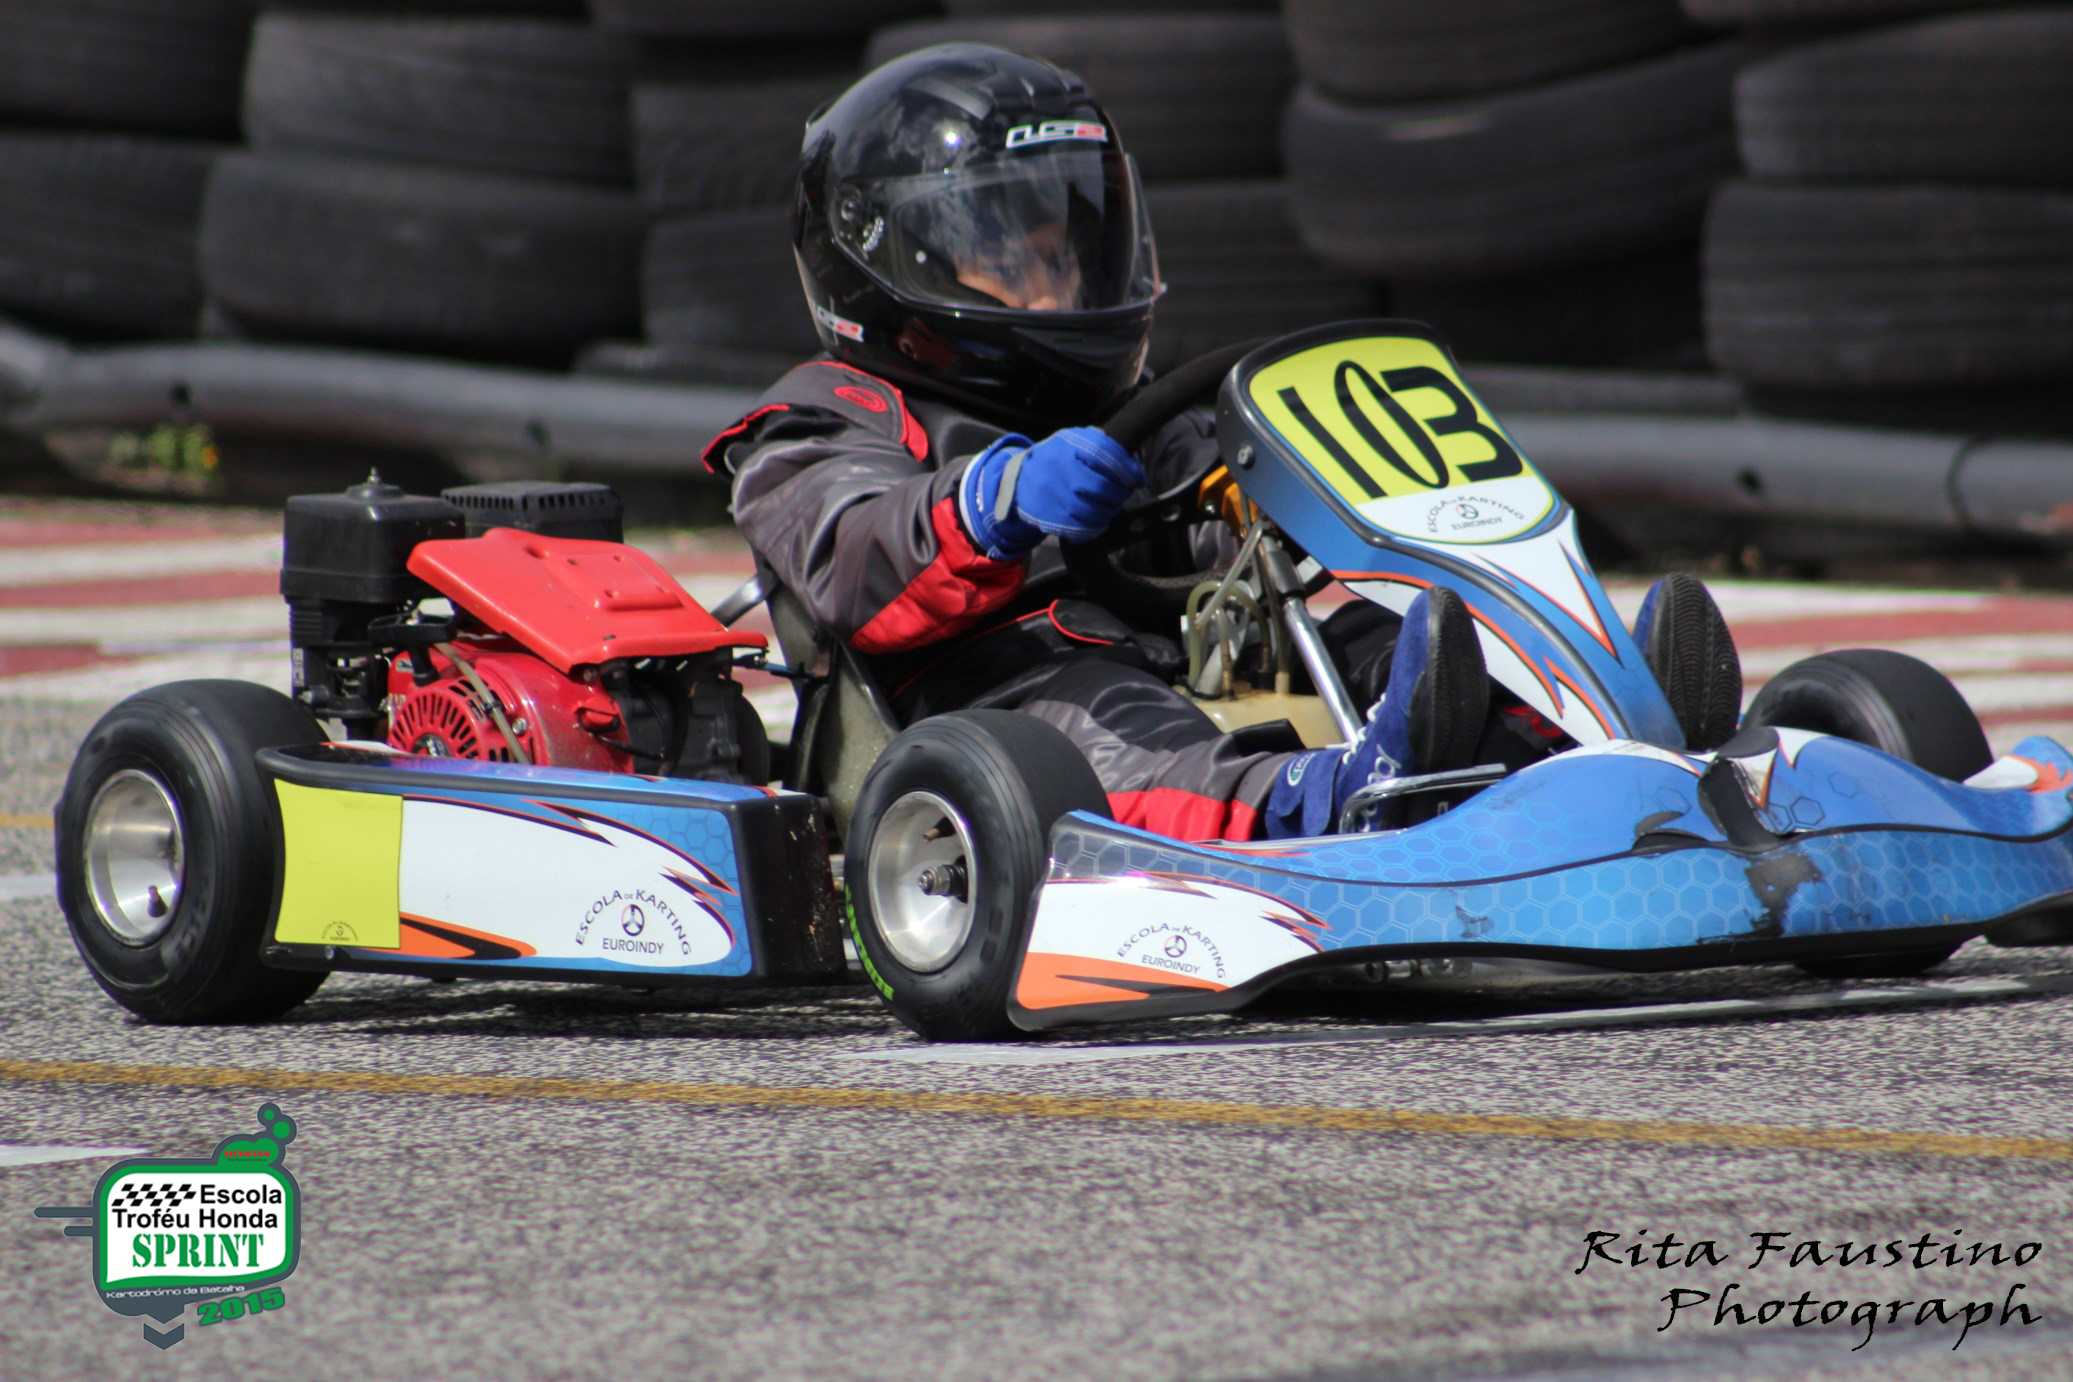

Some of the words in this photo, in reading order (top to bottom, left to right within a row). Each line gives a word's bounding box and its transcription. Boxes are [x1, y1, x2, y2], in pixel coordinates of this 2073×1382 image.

[1277, 360, 1523, 500] 103
[575, 889, 623, 946] ESCOLA
[635, 888, 691, 955] KARTING
[602, 937, 664, 955] EUROINDY
[1117, 923, 1170, 957] ESCOLA
[1182, 925, 1226, 979] KARTING
[1141, 954, 1201, 974] EUROINDY
